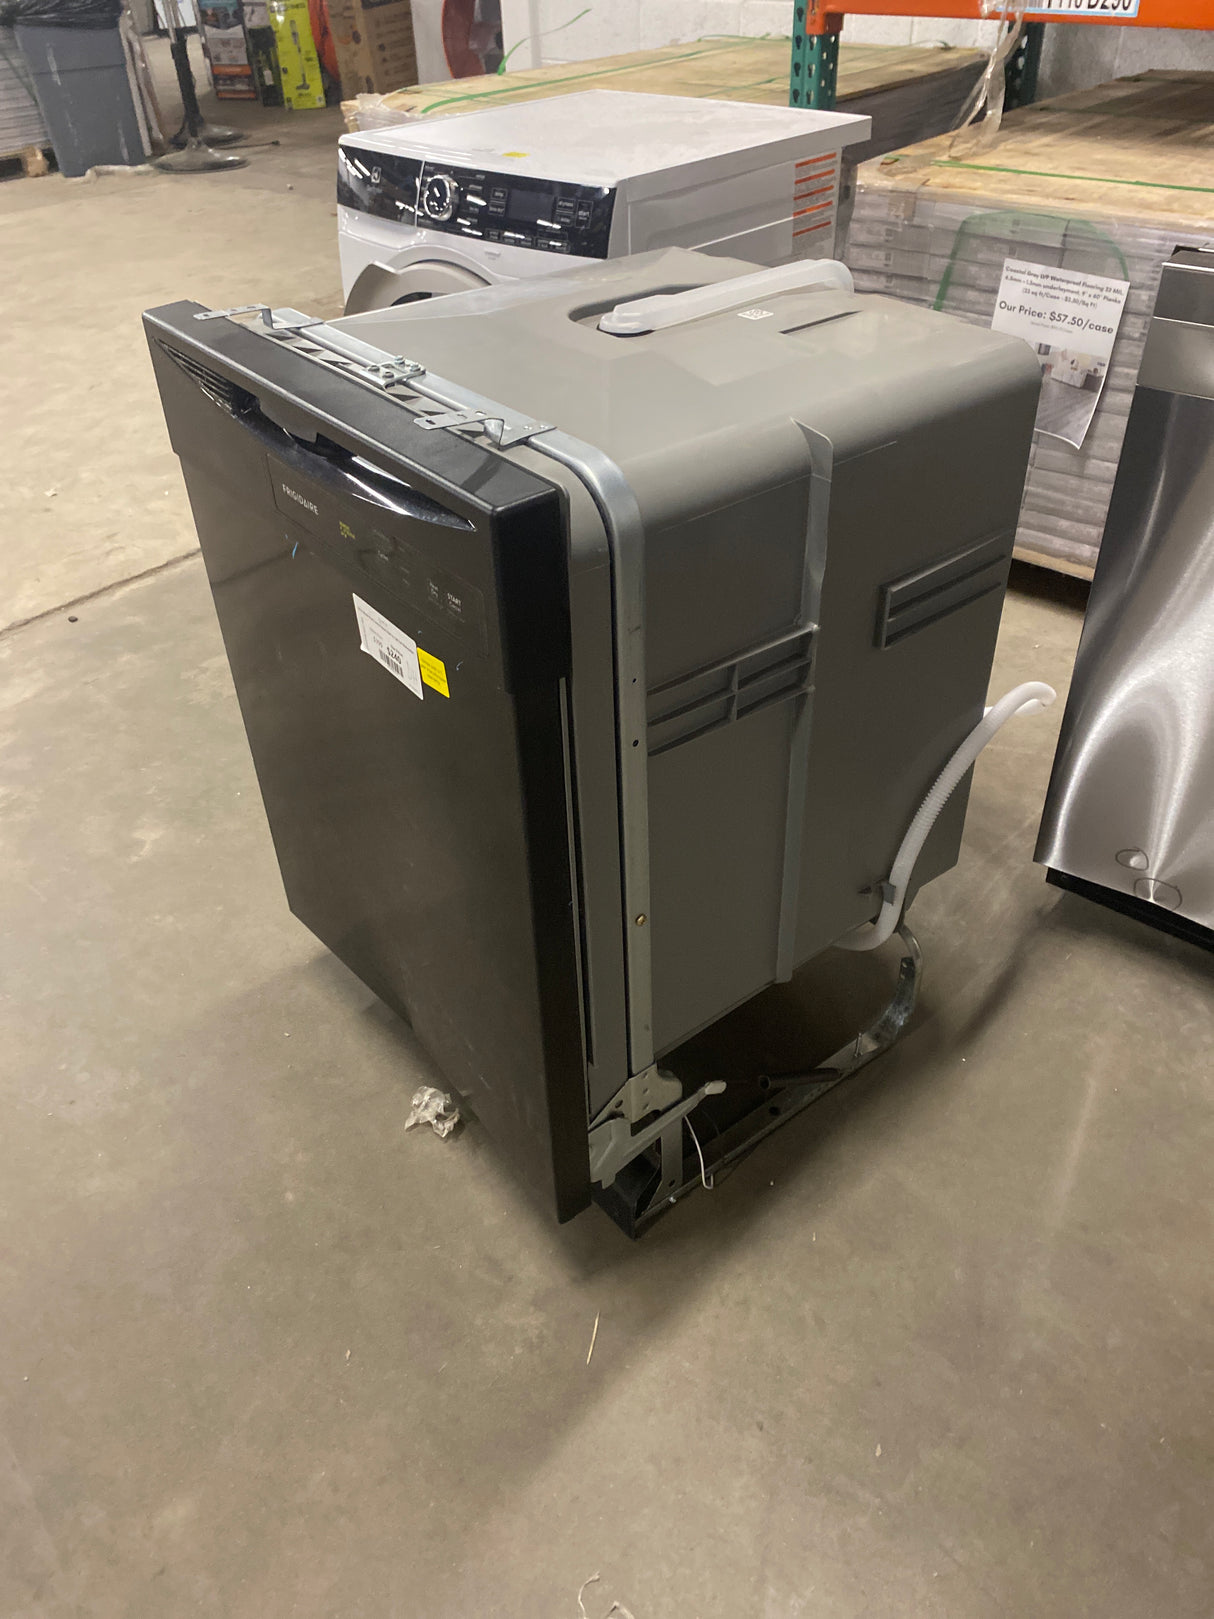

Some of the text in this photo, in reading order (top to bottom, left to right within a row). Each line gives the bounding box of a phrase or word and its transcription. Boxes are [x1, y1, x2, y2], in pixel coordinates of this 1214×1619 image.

[1050, 275, 1081, 286] Waterproof
[1082, 281, 1104, 293] Flooring
[999, 300, 1016, 313] Our
[1019, 305, 1047, 320] Price:
[1048, 311, 1114, 335] $57.50/case
[282, 483, 319, 516] FRIGIDAIRE
